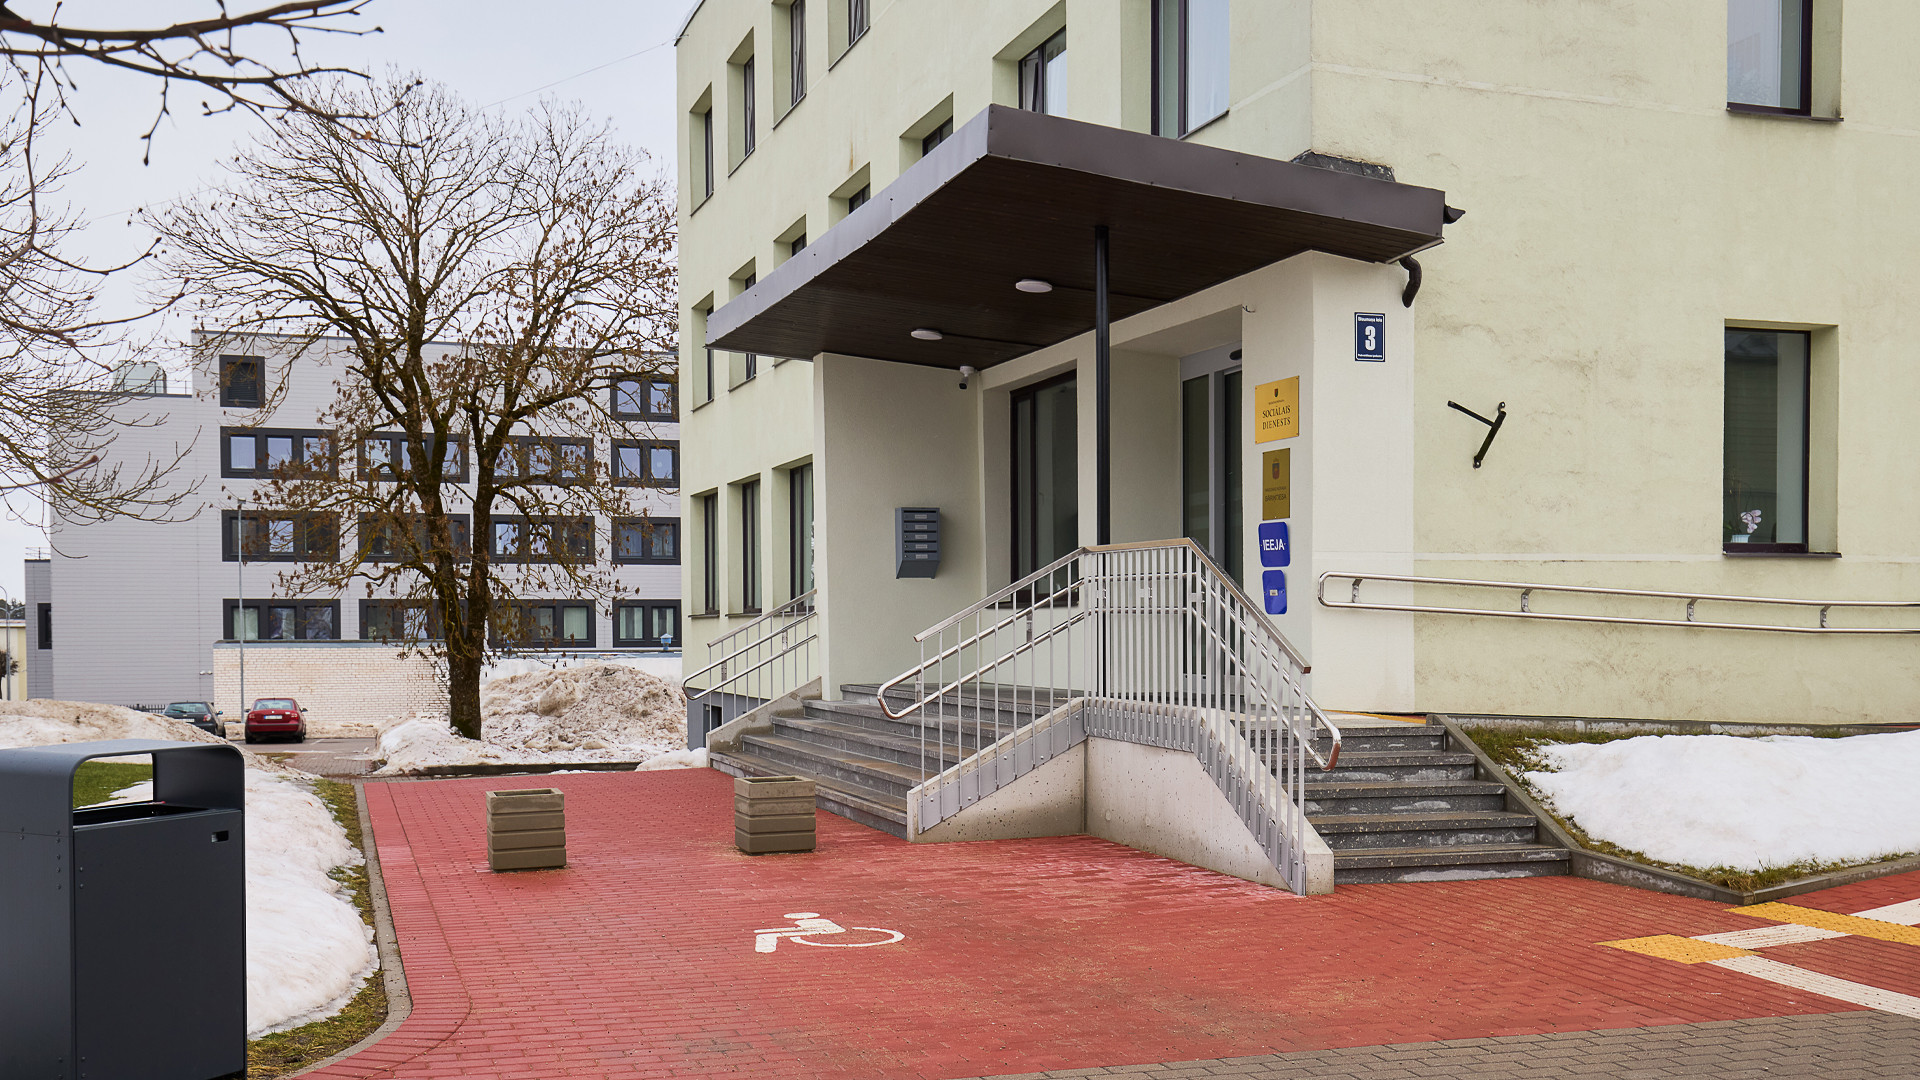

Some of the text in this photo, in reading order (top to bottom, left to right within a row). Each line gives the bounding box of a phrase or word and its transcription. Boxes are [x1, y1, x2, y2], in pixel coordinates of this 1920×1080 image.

[1365, 325, 1376, 351] 3
[1262, 405, 1291, 419] SOCIĀLAIS
[1262, 416, 1291, 430] DIENESTS
[1262, 538, 1285, 551] IEEJA
